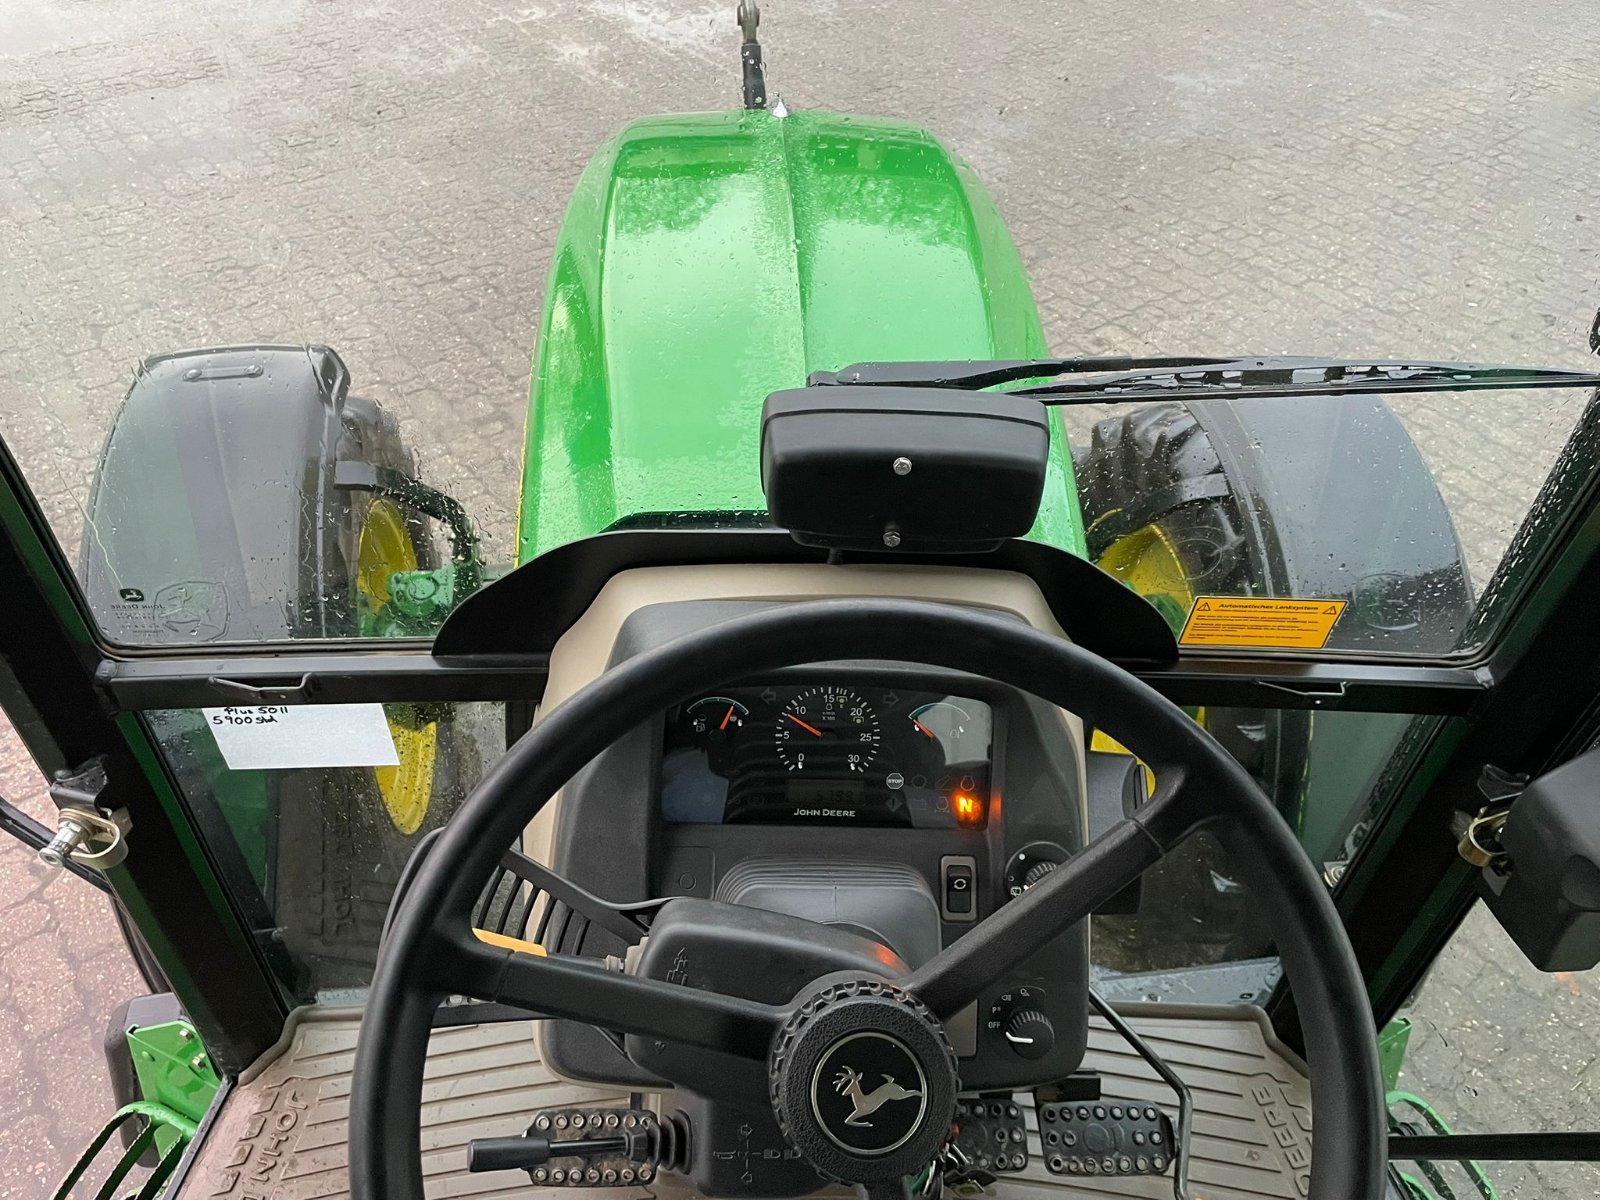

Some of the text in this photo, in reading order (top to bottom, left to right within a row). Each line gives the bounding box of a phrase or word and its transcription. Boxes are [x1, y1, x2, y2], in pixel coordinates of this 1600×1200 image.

[1218, 602, 1273, 610] Automatisches
[1274, 604, 1319, 612] Lenksystem
[823, 694, 835, 703] 15
[795, 706, 807, 715] 10
[850, 707, 863, 716] 20
[213, 715, 253, 725] 5900
[783, 730, 790, 740] 5
[860, 733, 872, 742] 25
[798, 752, 805, 761] 0
[847, 754, 860, 763] 30
[958, 797, 973, 813] N
[794, 808, 856, 817] JOHN DEERE
[988, 1021, 1001, 1029] OFF
